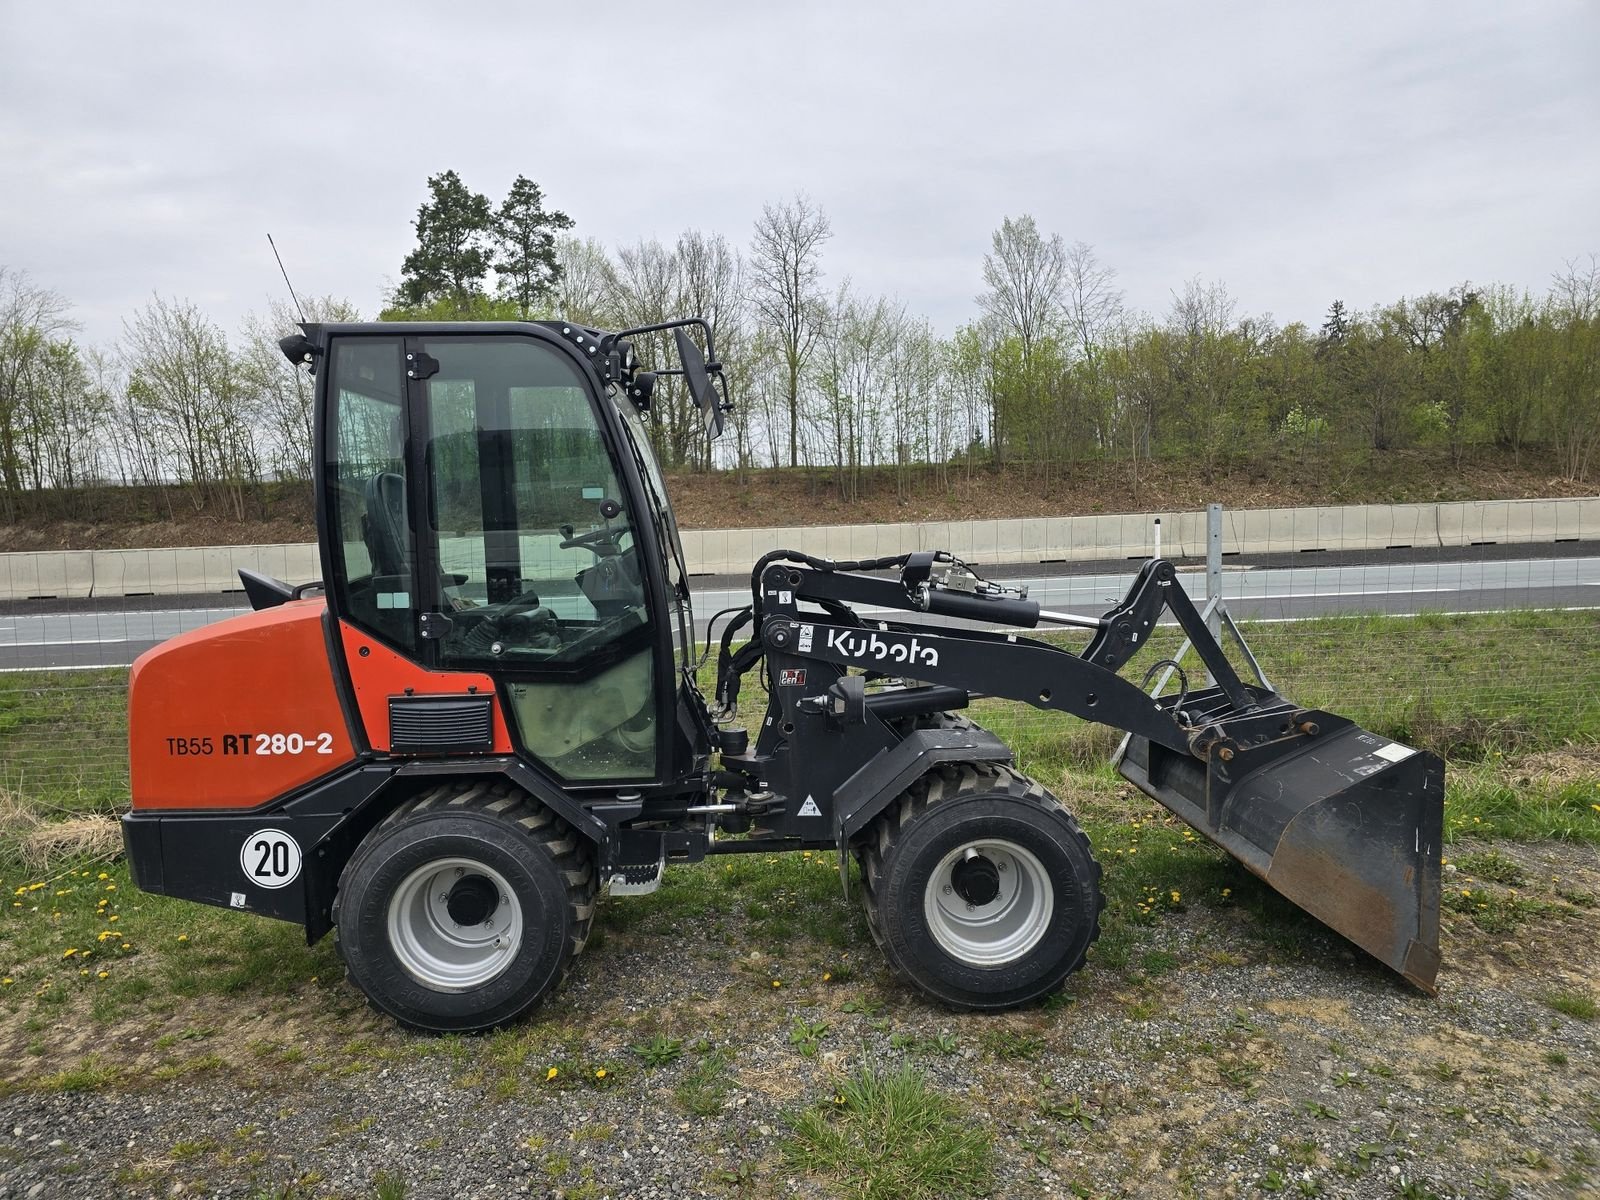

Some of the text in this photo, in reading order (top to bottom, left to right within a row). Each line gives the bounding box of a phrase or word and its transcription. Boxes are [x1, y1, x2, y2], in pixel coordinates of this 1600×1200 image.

[828, 629, 939, 667] Kubota
[167, 737, 213, 755] TB55
[254, 840, 289, 877] 20
